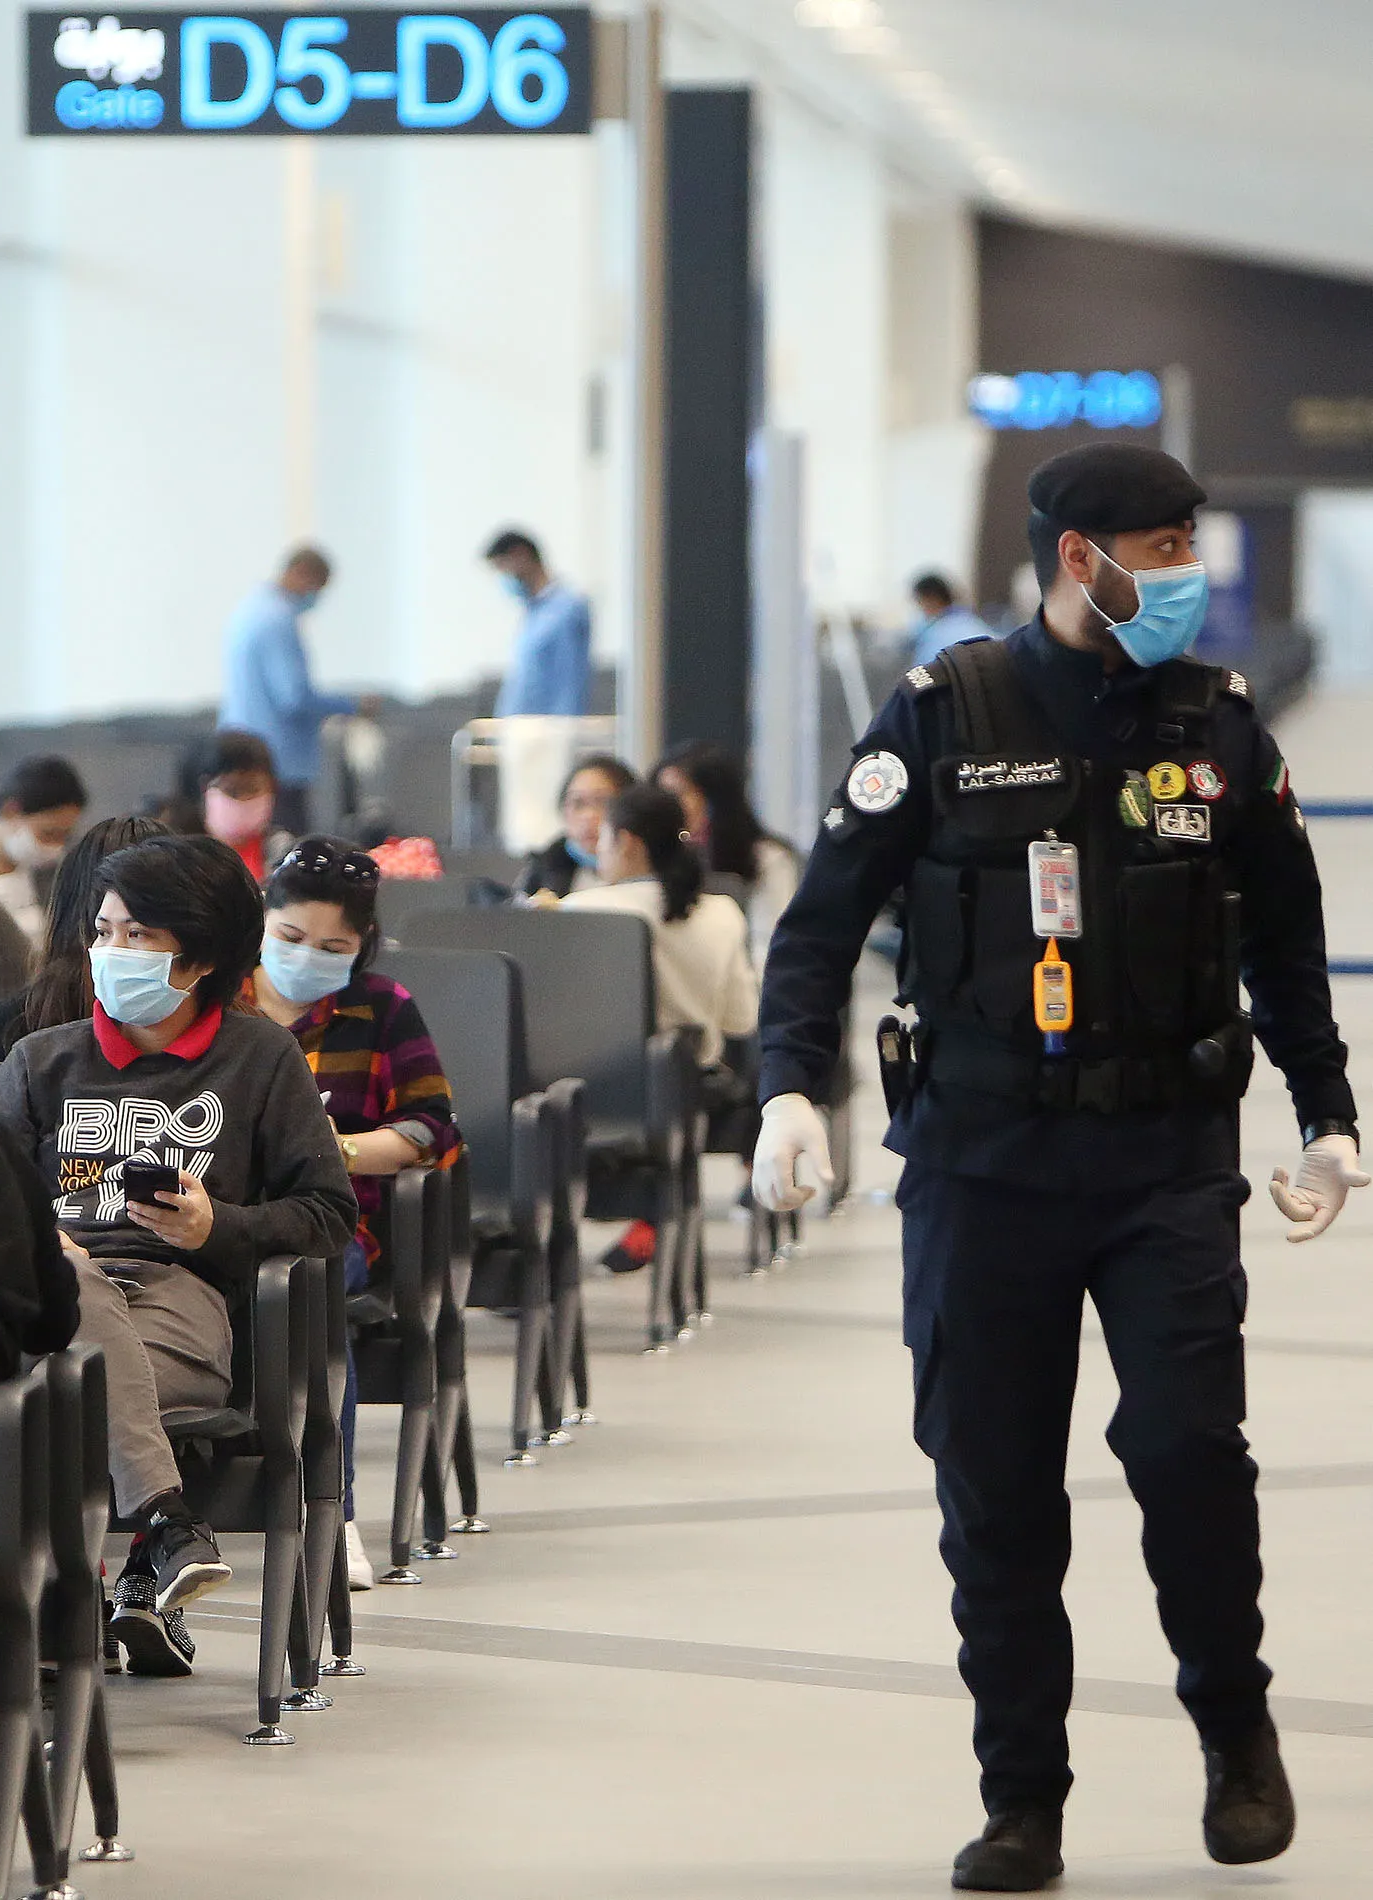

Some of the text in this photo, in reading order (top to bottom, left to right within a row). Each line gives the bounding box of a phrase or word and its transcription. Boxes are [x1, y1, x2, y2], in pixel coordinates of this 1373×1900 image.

[179, 14, 569, 129] D5-D6
[60, 1157, 105, 1177] NEW
[57, 1173, 103, 1193] YORK
